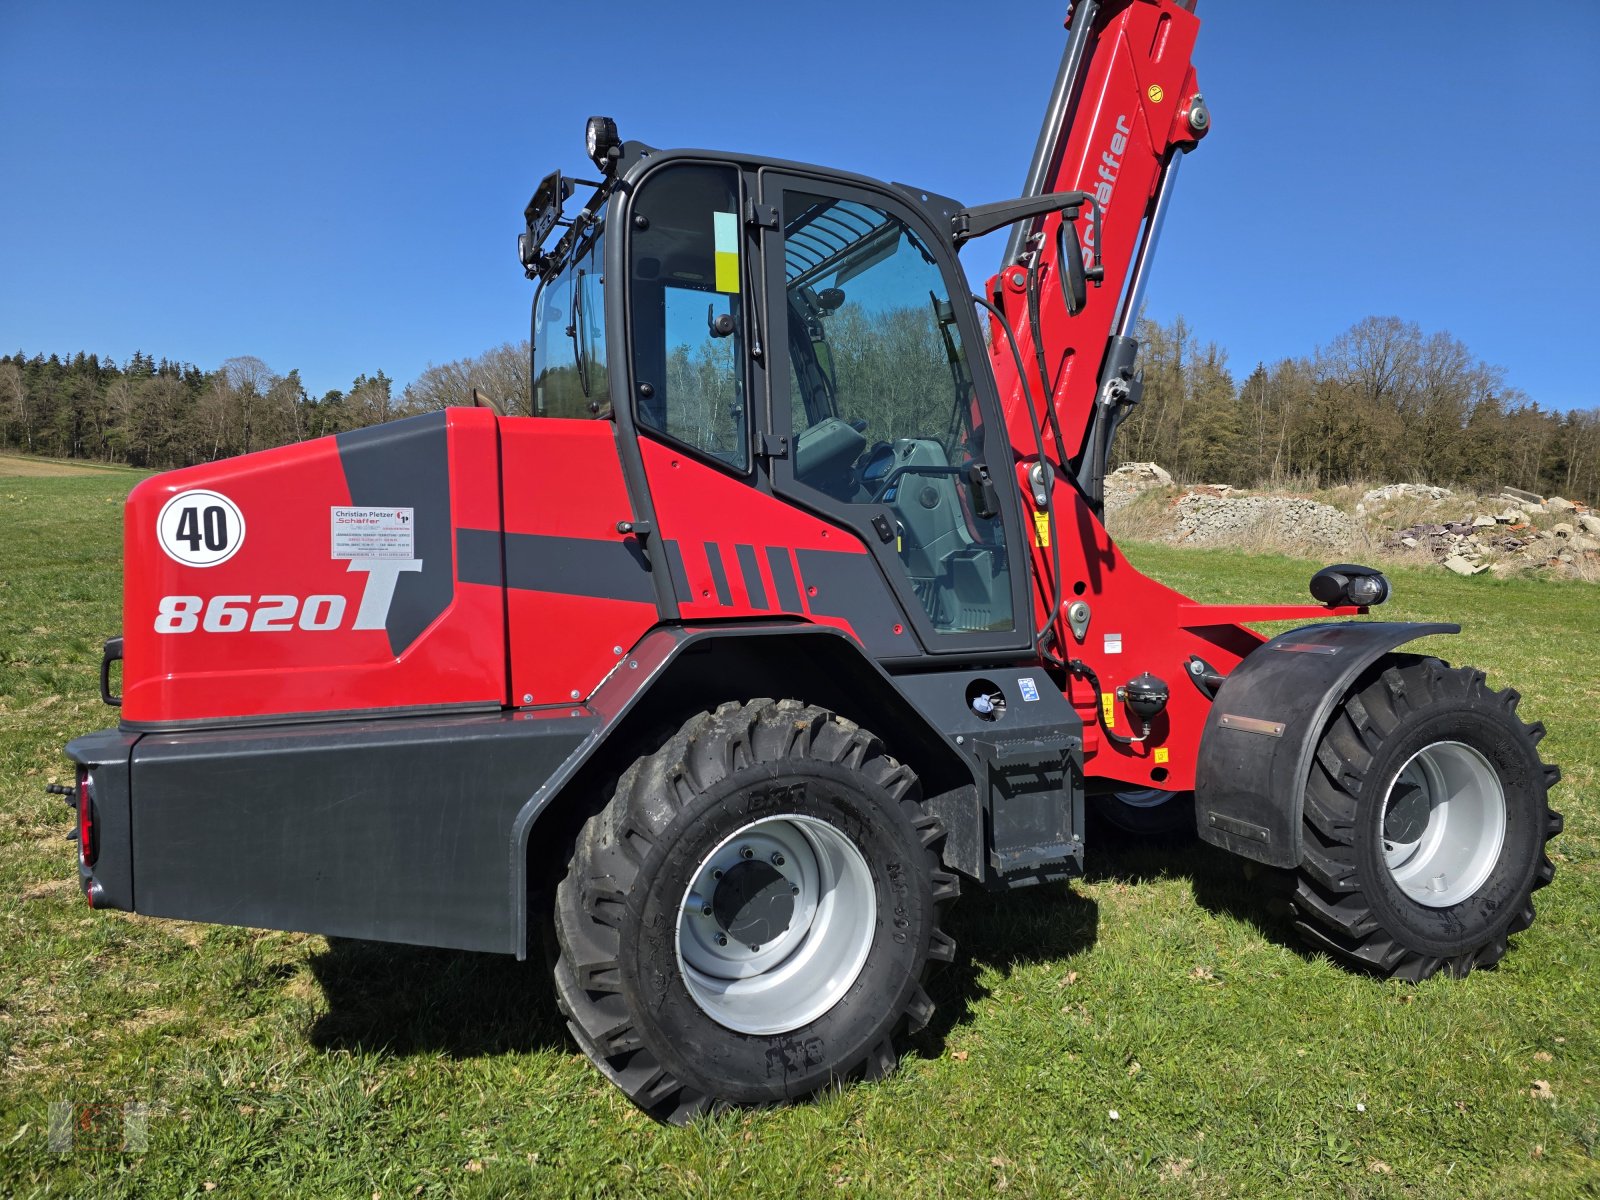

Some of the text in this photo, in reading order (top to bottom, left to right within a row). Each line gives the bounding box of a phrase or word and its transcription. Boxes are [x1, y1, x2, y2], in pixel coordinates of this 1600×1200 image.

[175, 505, 229, 552] 40
[153, 559, 424, 634] 8620 T
